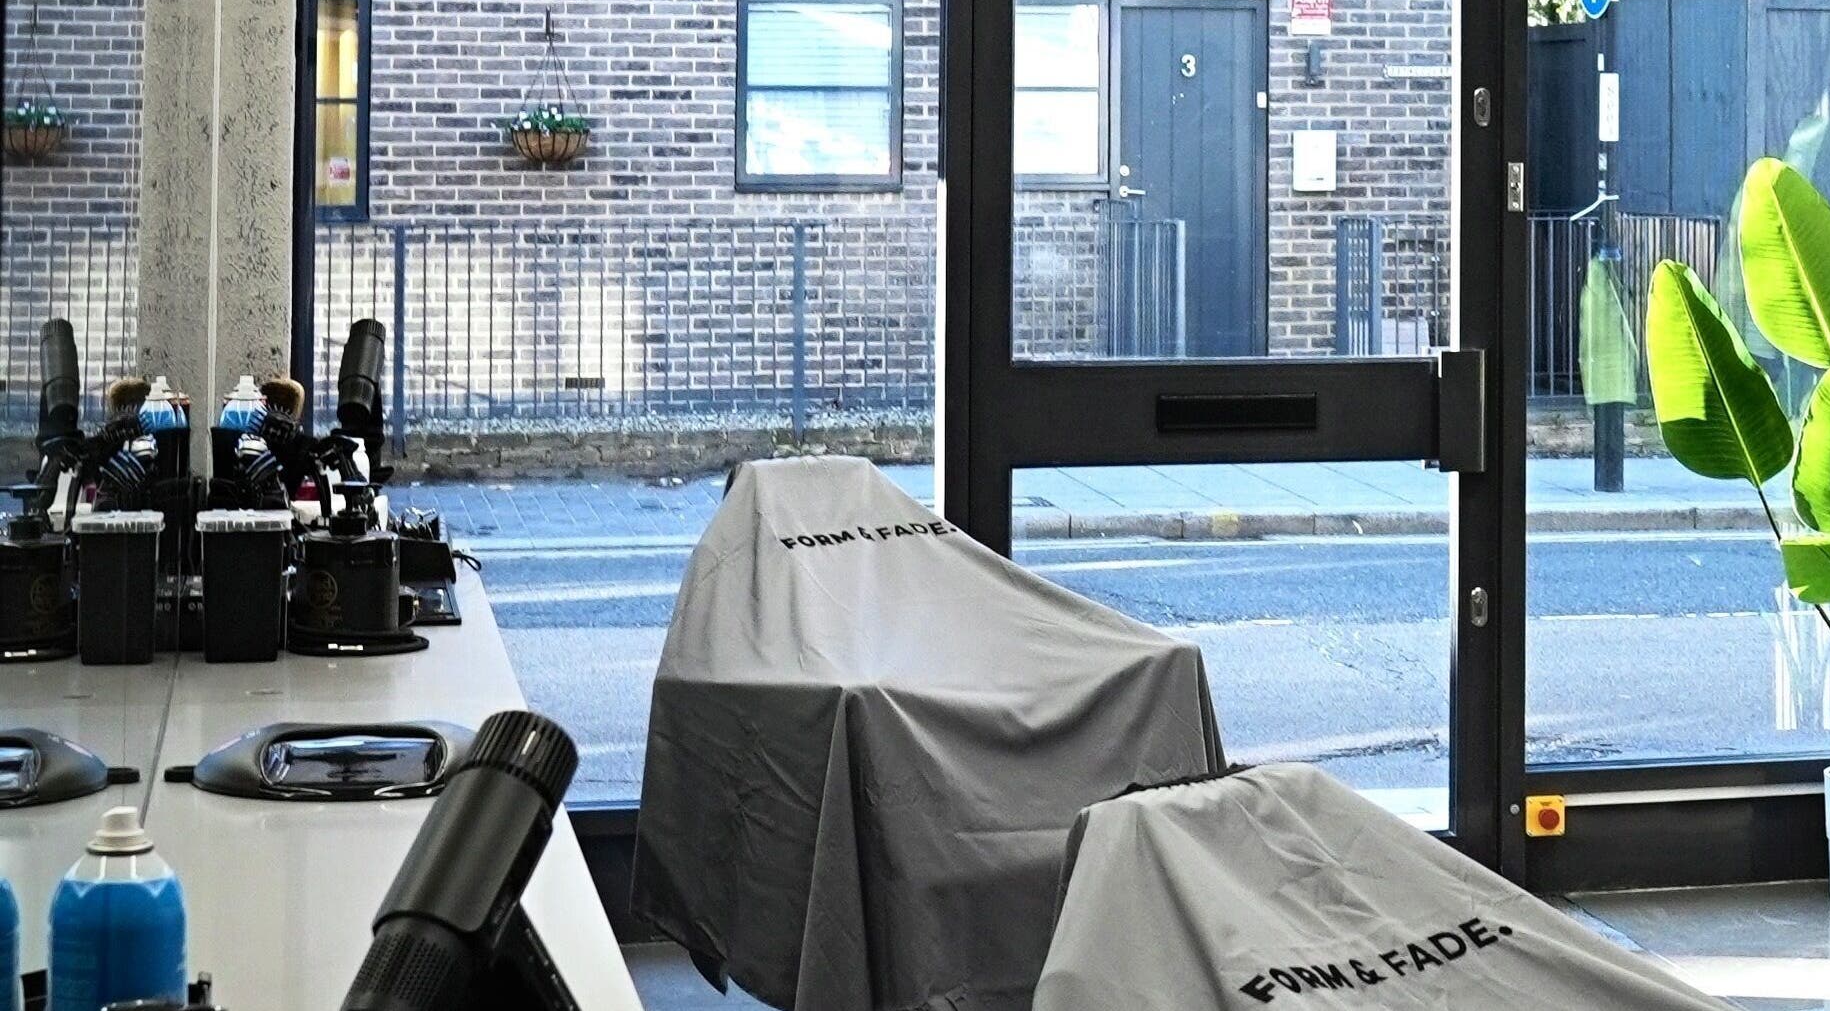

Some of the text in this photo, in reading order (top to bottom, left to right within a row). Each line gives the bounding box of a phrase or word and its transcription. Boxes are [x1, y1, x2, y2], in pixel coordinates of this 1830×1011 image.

[1181, 54, 1196, 78] 3
[780, 521, 957, 549] FORM & FADE.
[1239, 917, 1513, 1003] FORM & FADE.
